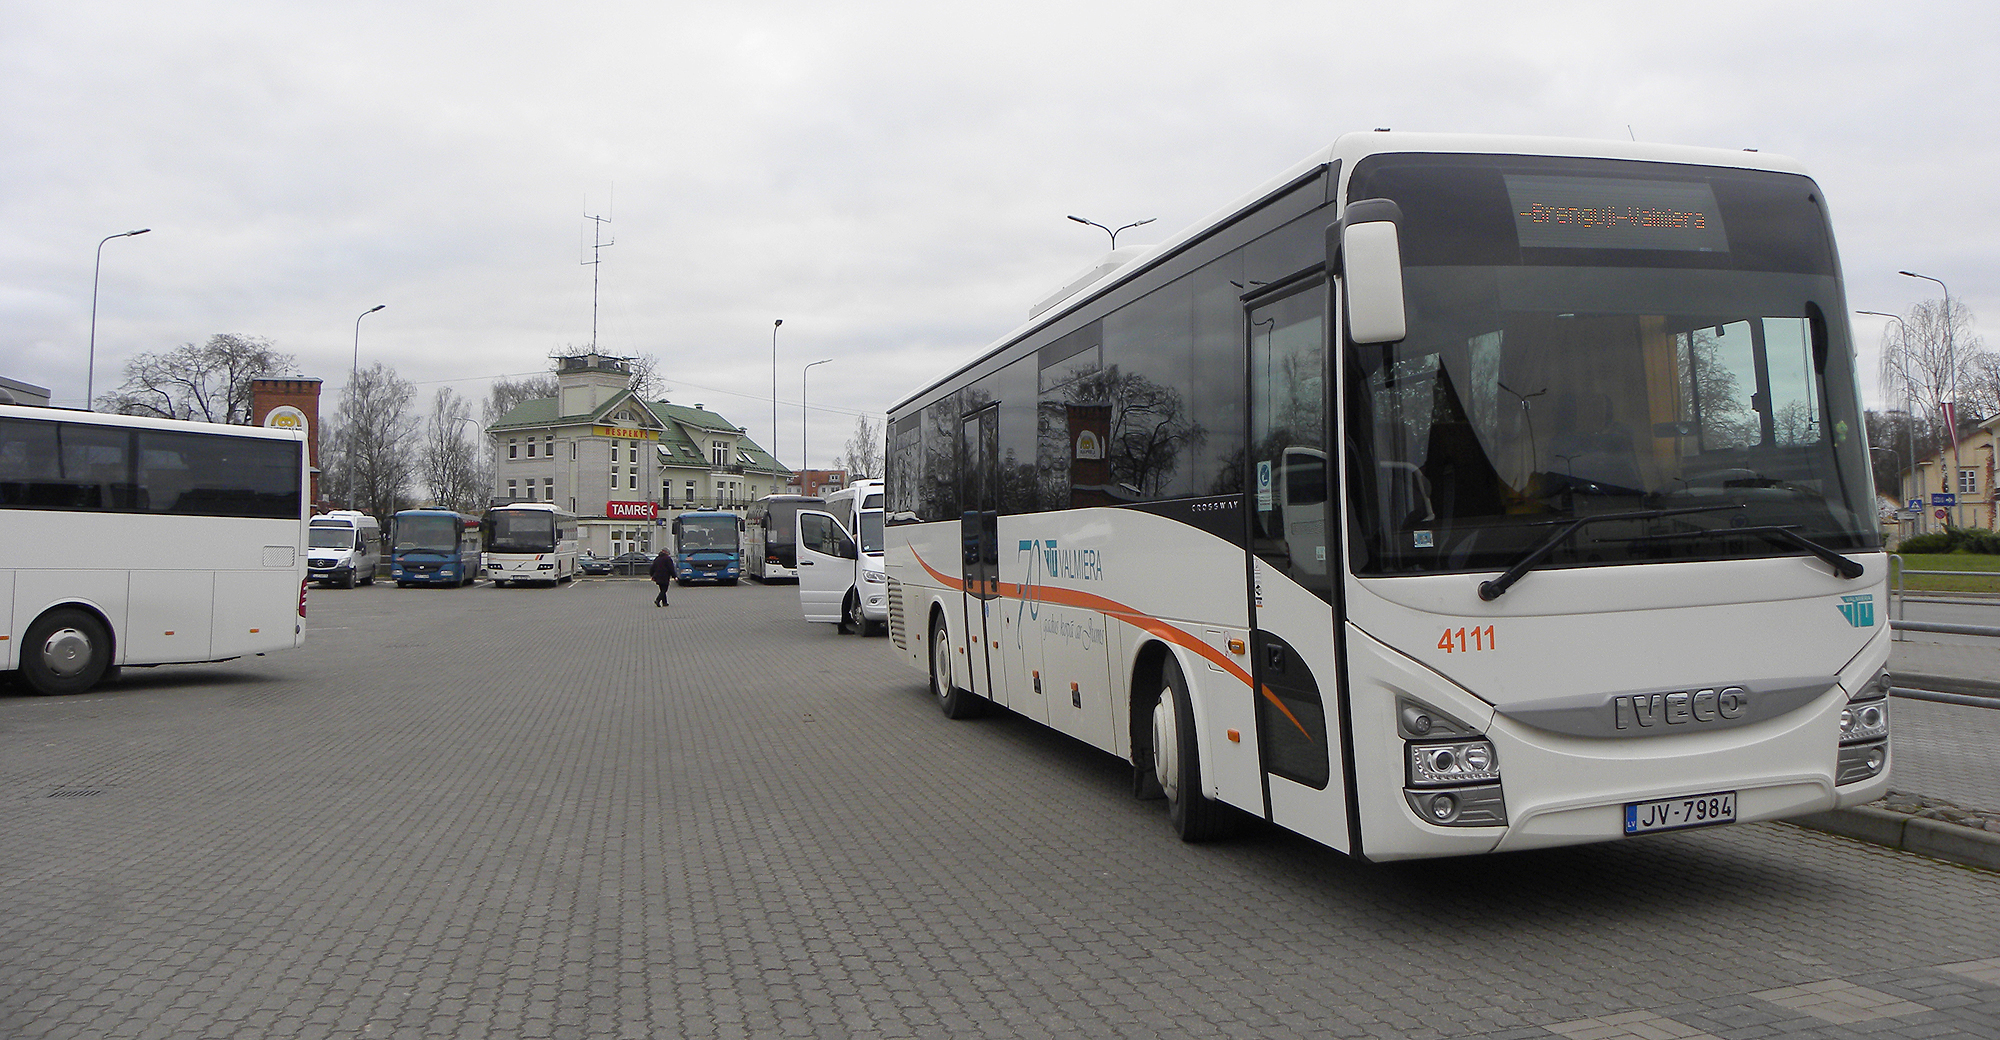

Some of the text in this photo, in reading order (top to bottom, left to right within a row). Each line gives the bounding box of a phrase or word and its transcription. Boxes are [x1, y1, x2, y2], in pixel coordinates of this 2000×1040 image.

[605, 427, 650, 439] RESPEKTS
[611, 504, 654, 516] TAMREX
[1191, 500, 1239, 512] CROSSWAY
[1058, 549, 1103, 581] VALMIERA
[1437, 625, 1495, 653] 4111
[1615, 686, 1748, 730] IVECO
[1642, 796, 1732, 827] JV-7984
